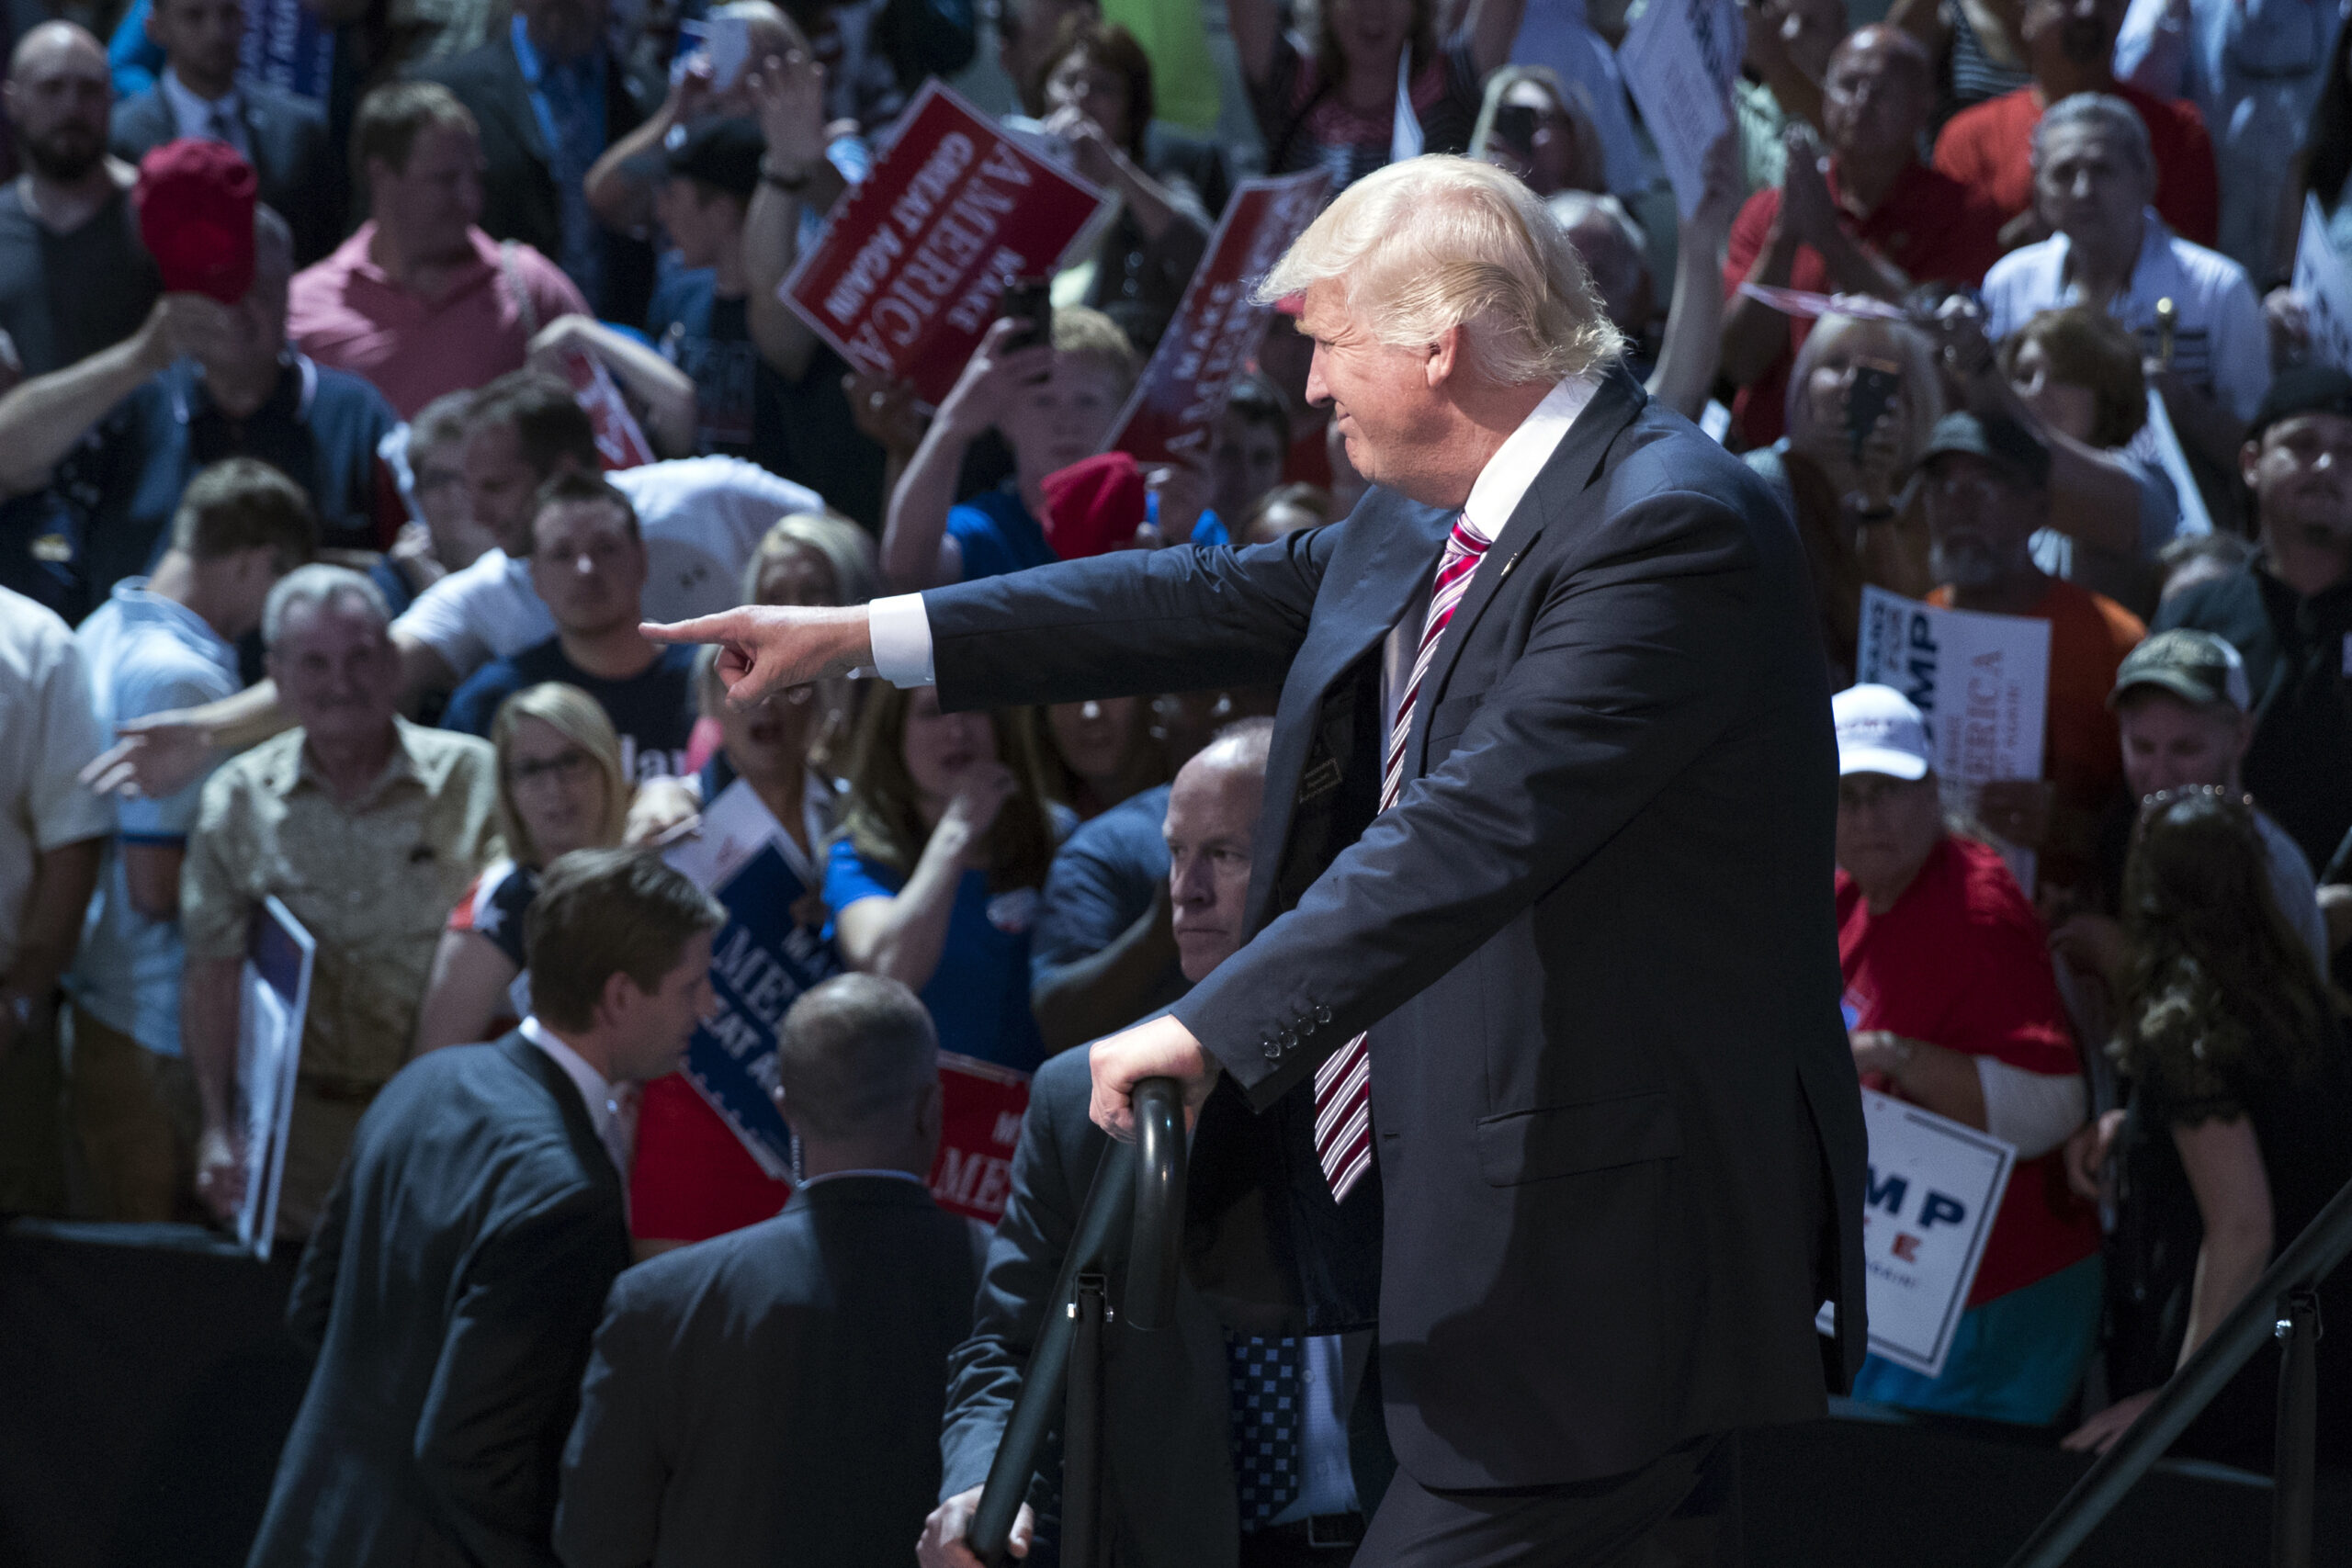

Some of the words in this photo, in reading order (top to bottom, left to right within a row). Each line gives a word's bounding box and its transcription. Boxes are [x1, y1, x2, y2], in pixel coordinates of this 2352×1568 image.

[892, 134, 977, 234] GREAT
[845, 141, 1033, 369] AMERICA
[1906, 613, 1938, 726] MP
